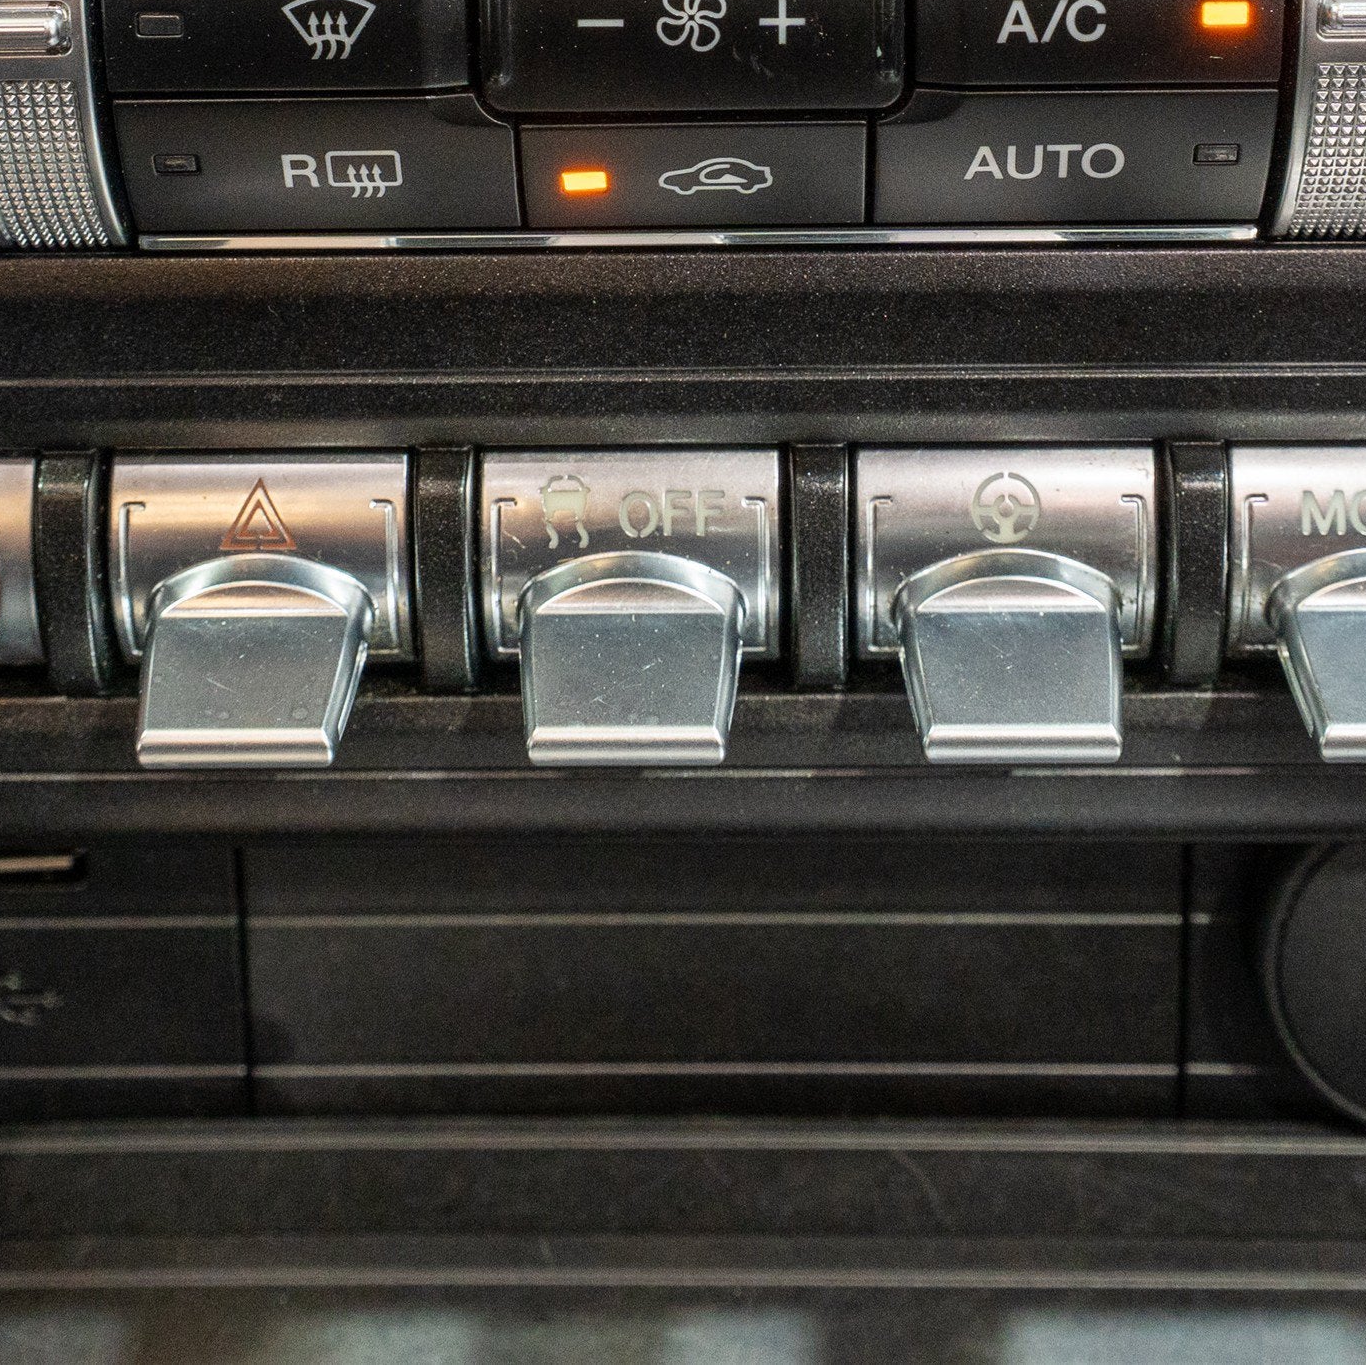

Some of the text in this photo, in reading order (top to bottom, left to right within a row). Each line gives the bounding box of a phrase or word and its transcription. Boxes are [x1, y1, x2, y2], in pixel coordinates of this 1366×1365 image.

[280, 153, 320, 189] R
[962, 143, 1126, 180] AUTO
[618, 489, 727, 538] OFF
